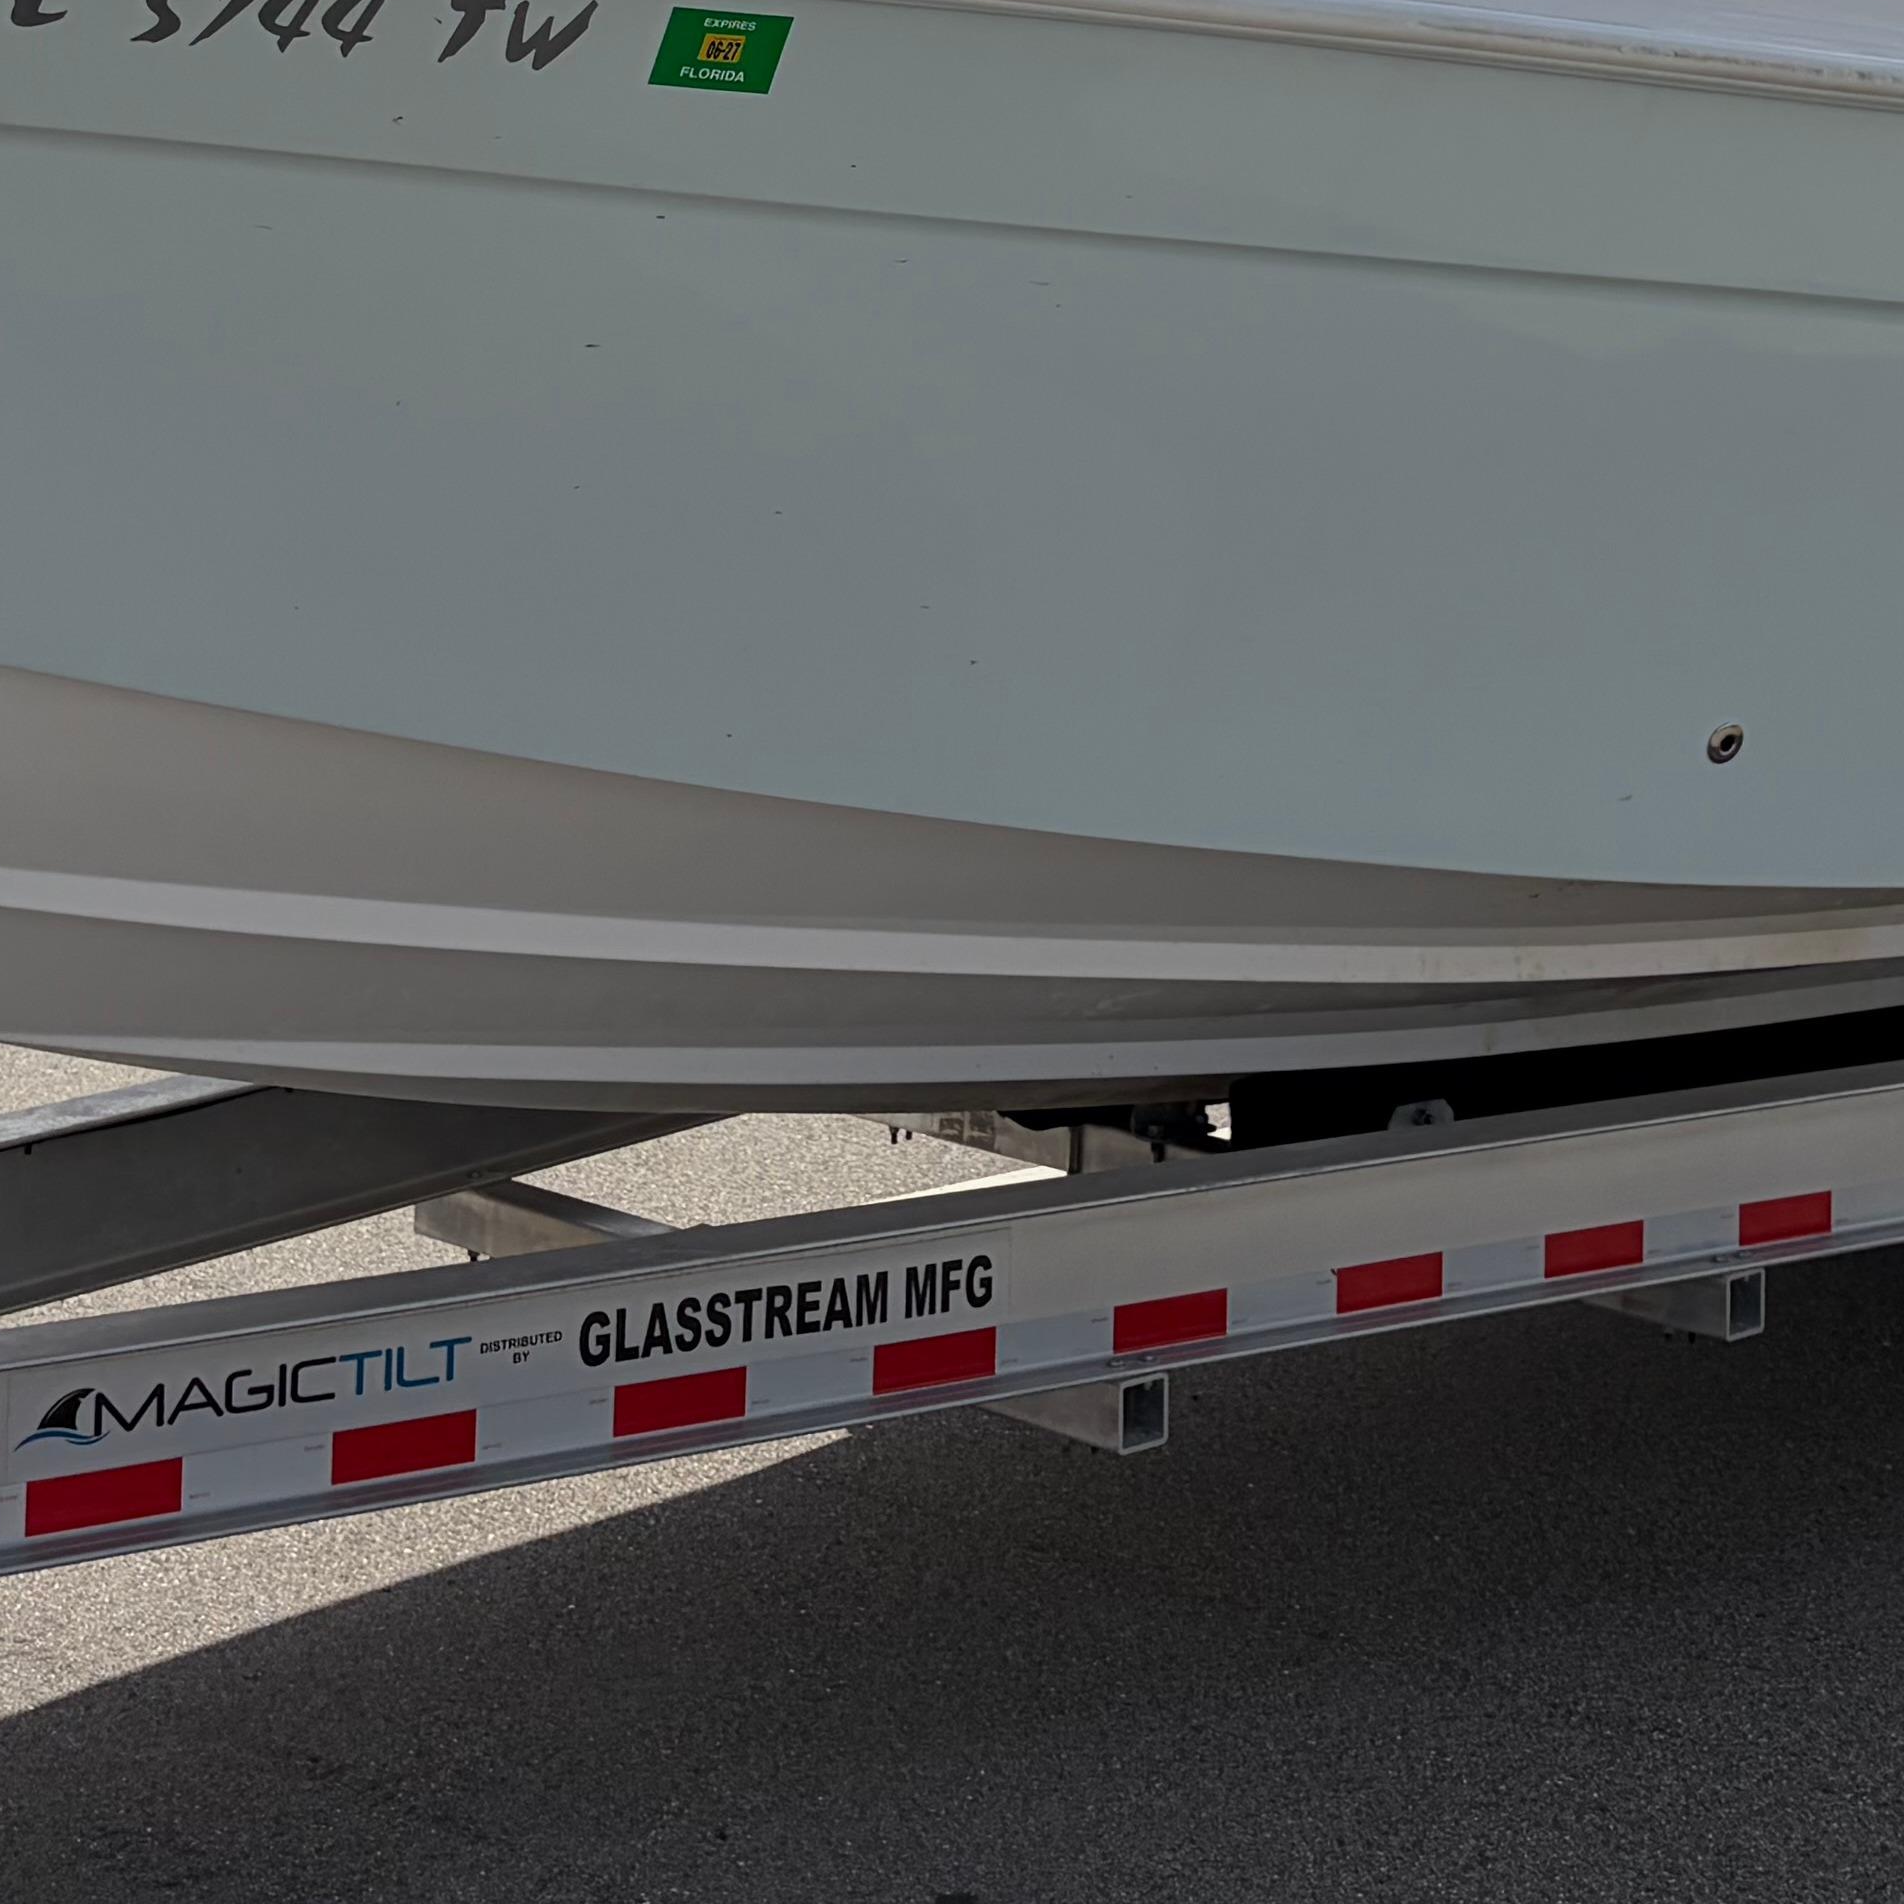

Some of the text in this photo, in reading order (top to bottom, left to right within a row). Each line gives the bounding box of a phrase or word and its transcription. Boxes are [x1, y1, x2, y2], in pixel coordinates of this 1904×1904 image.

[703, 17, 758, 32] EXPIRES
[706, 40, 741, 61] 06-27
[679, 66, 744, 82] FLORIDA
[578, 1254, 994, 1368] GLASSTREAM MFG
[480, 1330, 563, 1355] DISTRIBUTED
[512, 1350, 530, 1364] BY
[94, 1335, 474, 1438] MAGICTILT
